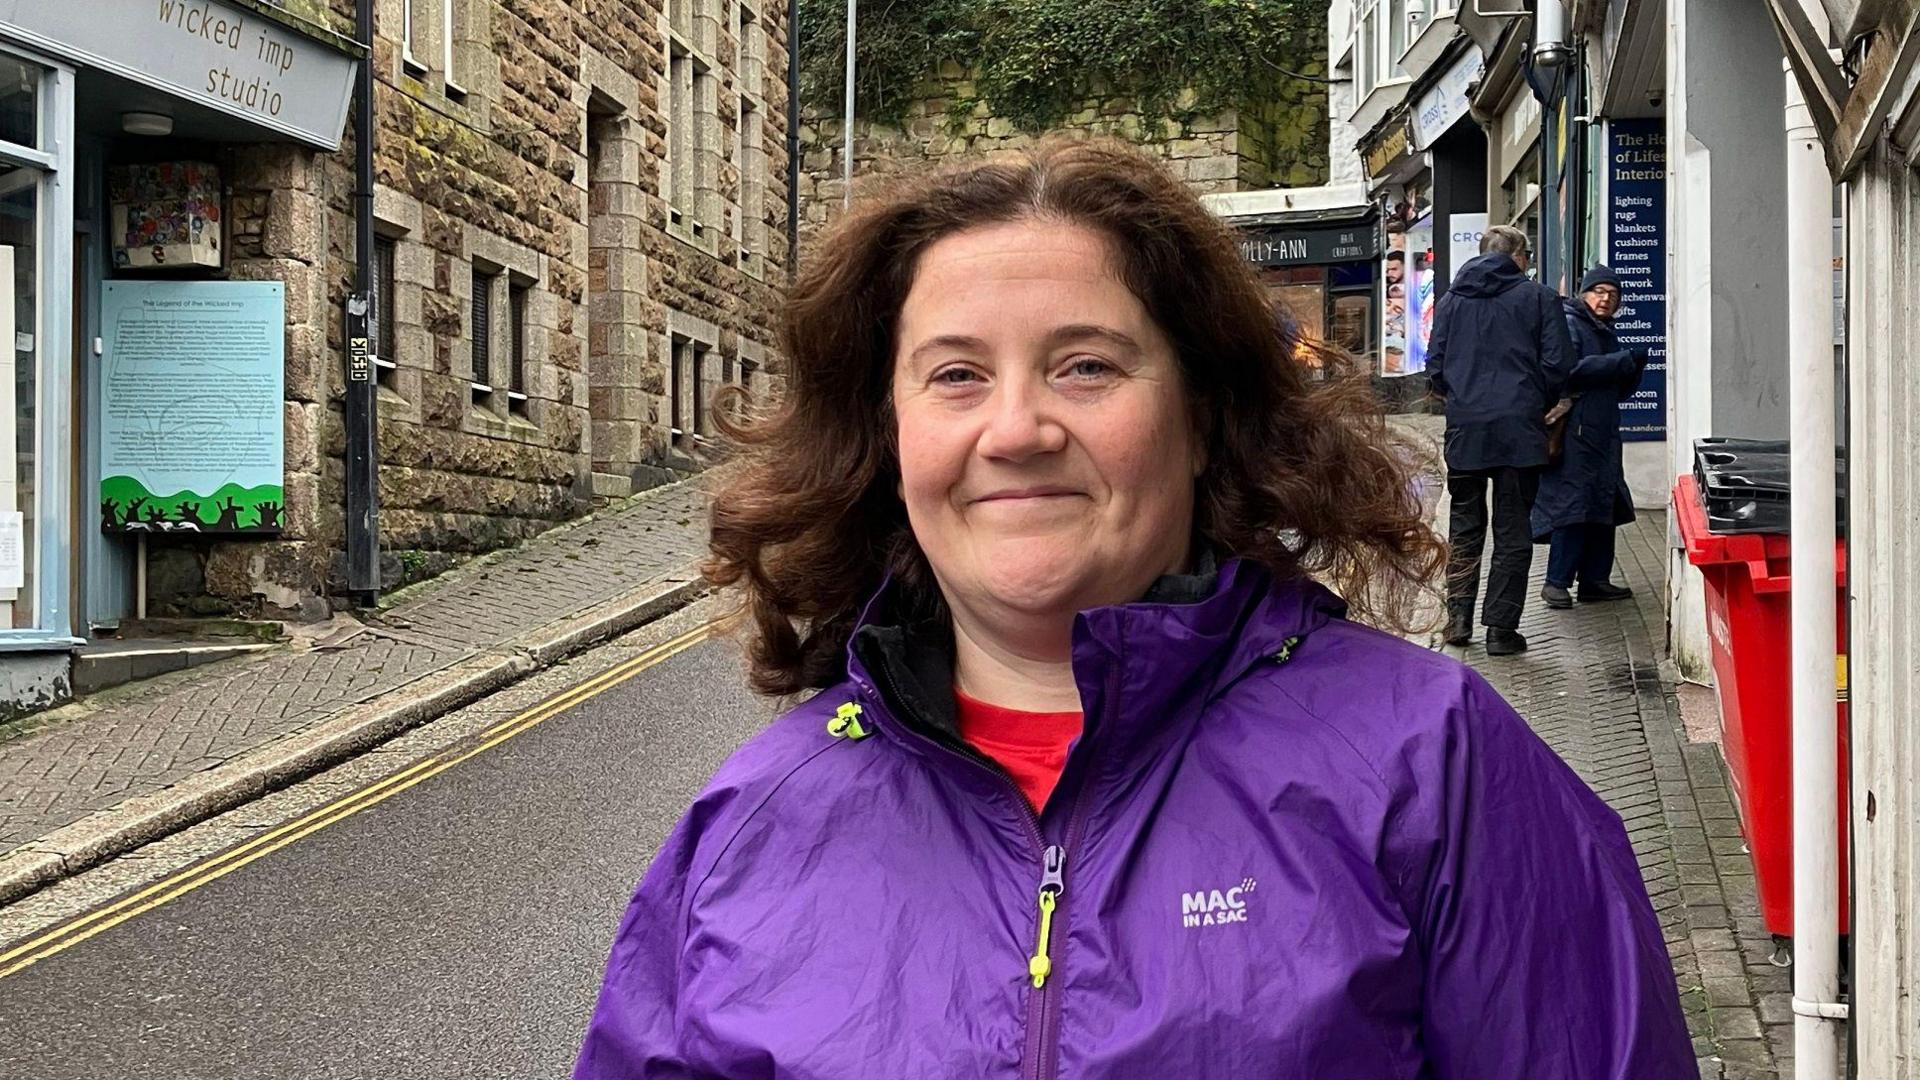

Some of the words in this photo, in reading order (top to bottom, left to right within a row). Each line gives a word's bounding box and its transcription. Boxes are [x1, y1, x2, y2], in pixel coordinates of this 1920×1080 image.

[159, 0, 243, 50] wicked
[257, 29, 294, 76] imp
[205, 67, 282, 116] studio
[1615, 133, 1644, 146] The
[1648, 133, 1666, 145] Ho
[1615, 150, 1631, 163] of
[1633, 149, 1666, 163] Lifes
[1615, 167, 1666, 180] Interio
[1615, 196, 1653, 207] lighting
[1615, 211, 1637, 222] rugs
[1615, 224, 1656, 233] blankets
[1452, 231, 1484, 242] CRO
[1614, 237, 1658, 247] cushions
[1241, 238, 1307, 261] OLLY-ANN
[1615, 251, 1649, 261] frames
[1615, 265, 1651, 275] mirrors
[1620, 278, 1653, 288] rtwork
[1620, 292, 1666, 302] itchenwa
[1615, 306, 1636, 318] gifts
[1614, 320, 1651, 329] candles
[1647, 347, 1666, 356] furn
[1631, 390, 1657, 398] oom
[1618, 400, 1658, 410] urniture
[1182, 886, 1246, 915] MAC
[1183, 913, 1200, 928] IN
[1202, 913, 1215, 926] A
[1216, 908, 1248, 924] SAC
